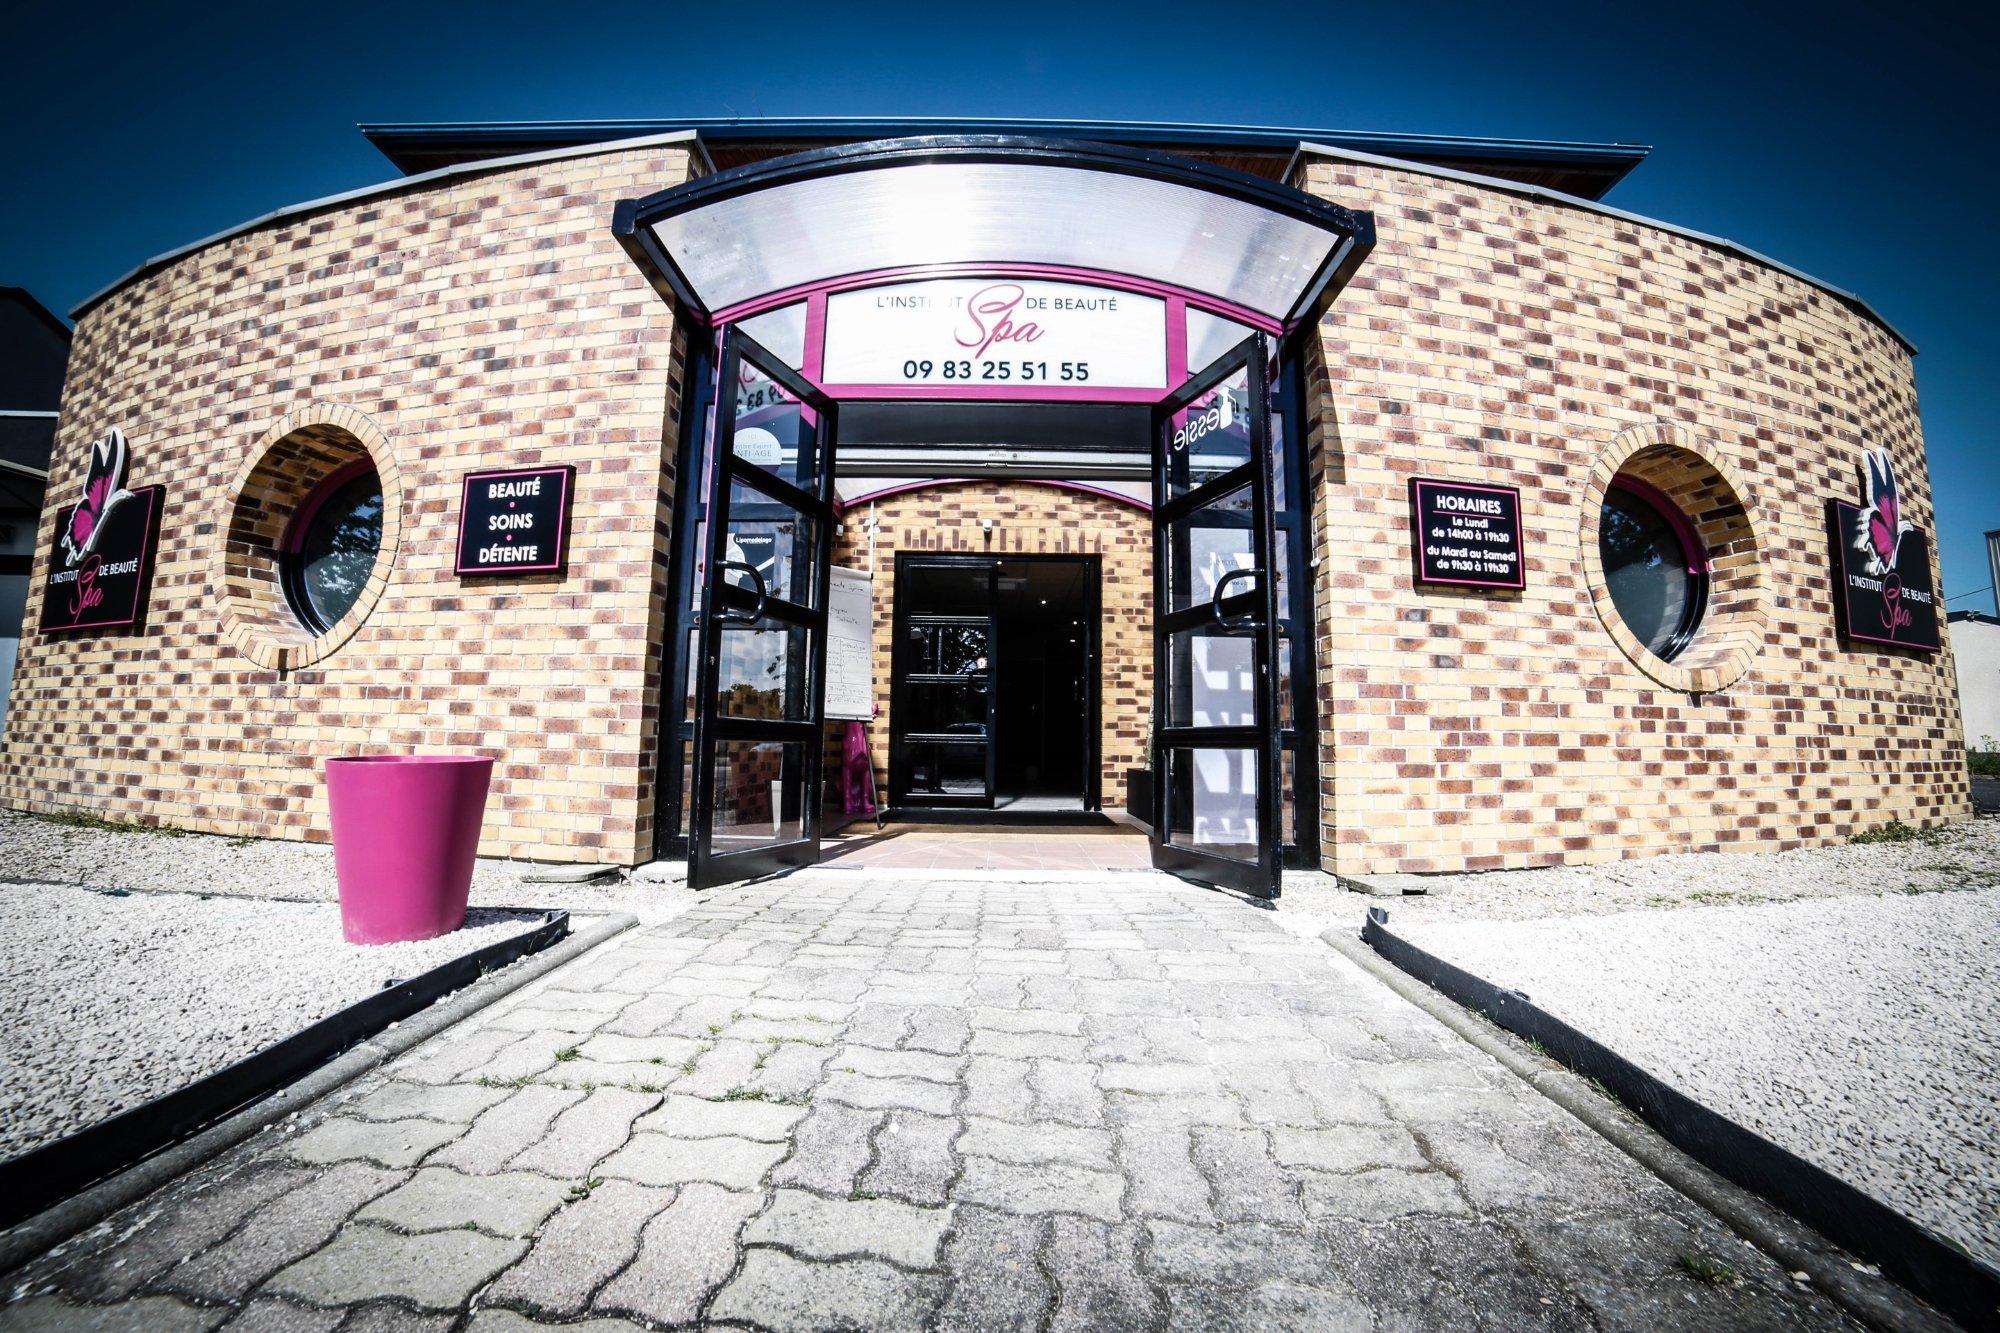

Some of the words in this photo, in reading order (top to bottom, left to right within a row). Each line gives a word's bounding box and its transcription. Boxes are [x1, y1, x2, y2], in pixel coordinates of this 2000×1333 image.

[1026, 297, 1047, 310] DE
[1054, 297, 1118, 312] BEAUTÉ
[953, 284, 1045, 359] Spa
[903, 360, 933, 379] 09
[943, 361, 972, 379] 83
[982, 361, 1011, 380] 25
[1021, 362, 1047, 380] 51
[1060, 363, 1089, 381] 55
[735, 449, 773, 457] NTI-AGE
[488, 476, 541, 499] BEAUTÉ
[1436, 495, 1502, 514] HORAIRES
[488, 513, 533, 530] SOINS
[1452, 516, 1463, 527] Le
[1465, 517, 1489, 529] Lundi
[1432, 527, 1445, 538] de
[1447, 528, 1474, 540] 14h00
[1475, 530, 1482, 541] à
[1484, 532, 1510, 543] 19h30
[479, 543, 538, 563] DÉTENTE
[1427, 545, 1440, 556] du
[1442, 546, 1468, 558] Mardi
[1470, 550, 1482, 559] au
[1483, 549, 1517, 562] Samedi
[50, 569, 80, 585] L'INSTITUT
[99, 564, 109, 577] DE
[110, 557, 138, 575] BEAUTÉ
[1437, 559, 1450, 569] de
[1451, 560, 1473, 571] 9h30
[1475, 561, 1482, 572] à
[1483, 562, 1509, 574] 19h30
[69, 553, 104, 625] Spa
[1849, 574, 1883, 593] L'INSTITUT
[1902, 587, 1910, 599] DE
[1911, 589, 1932, 604] BEAUTÉ
[1880, 572, 1912, 640] Spa
